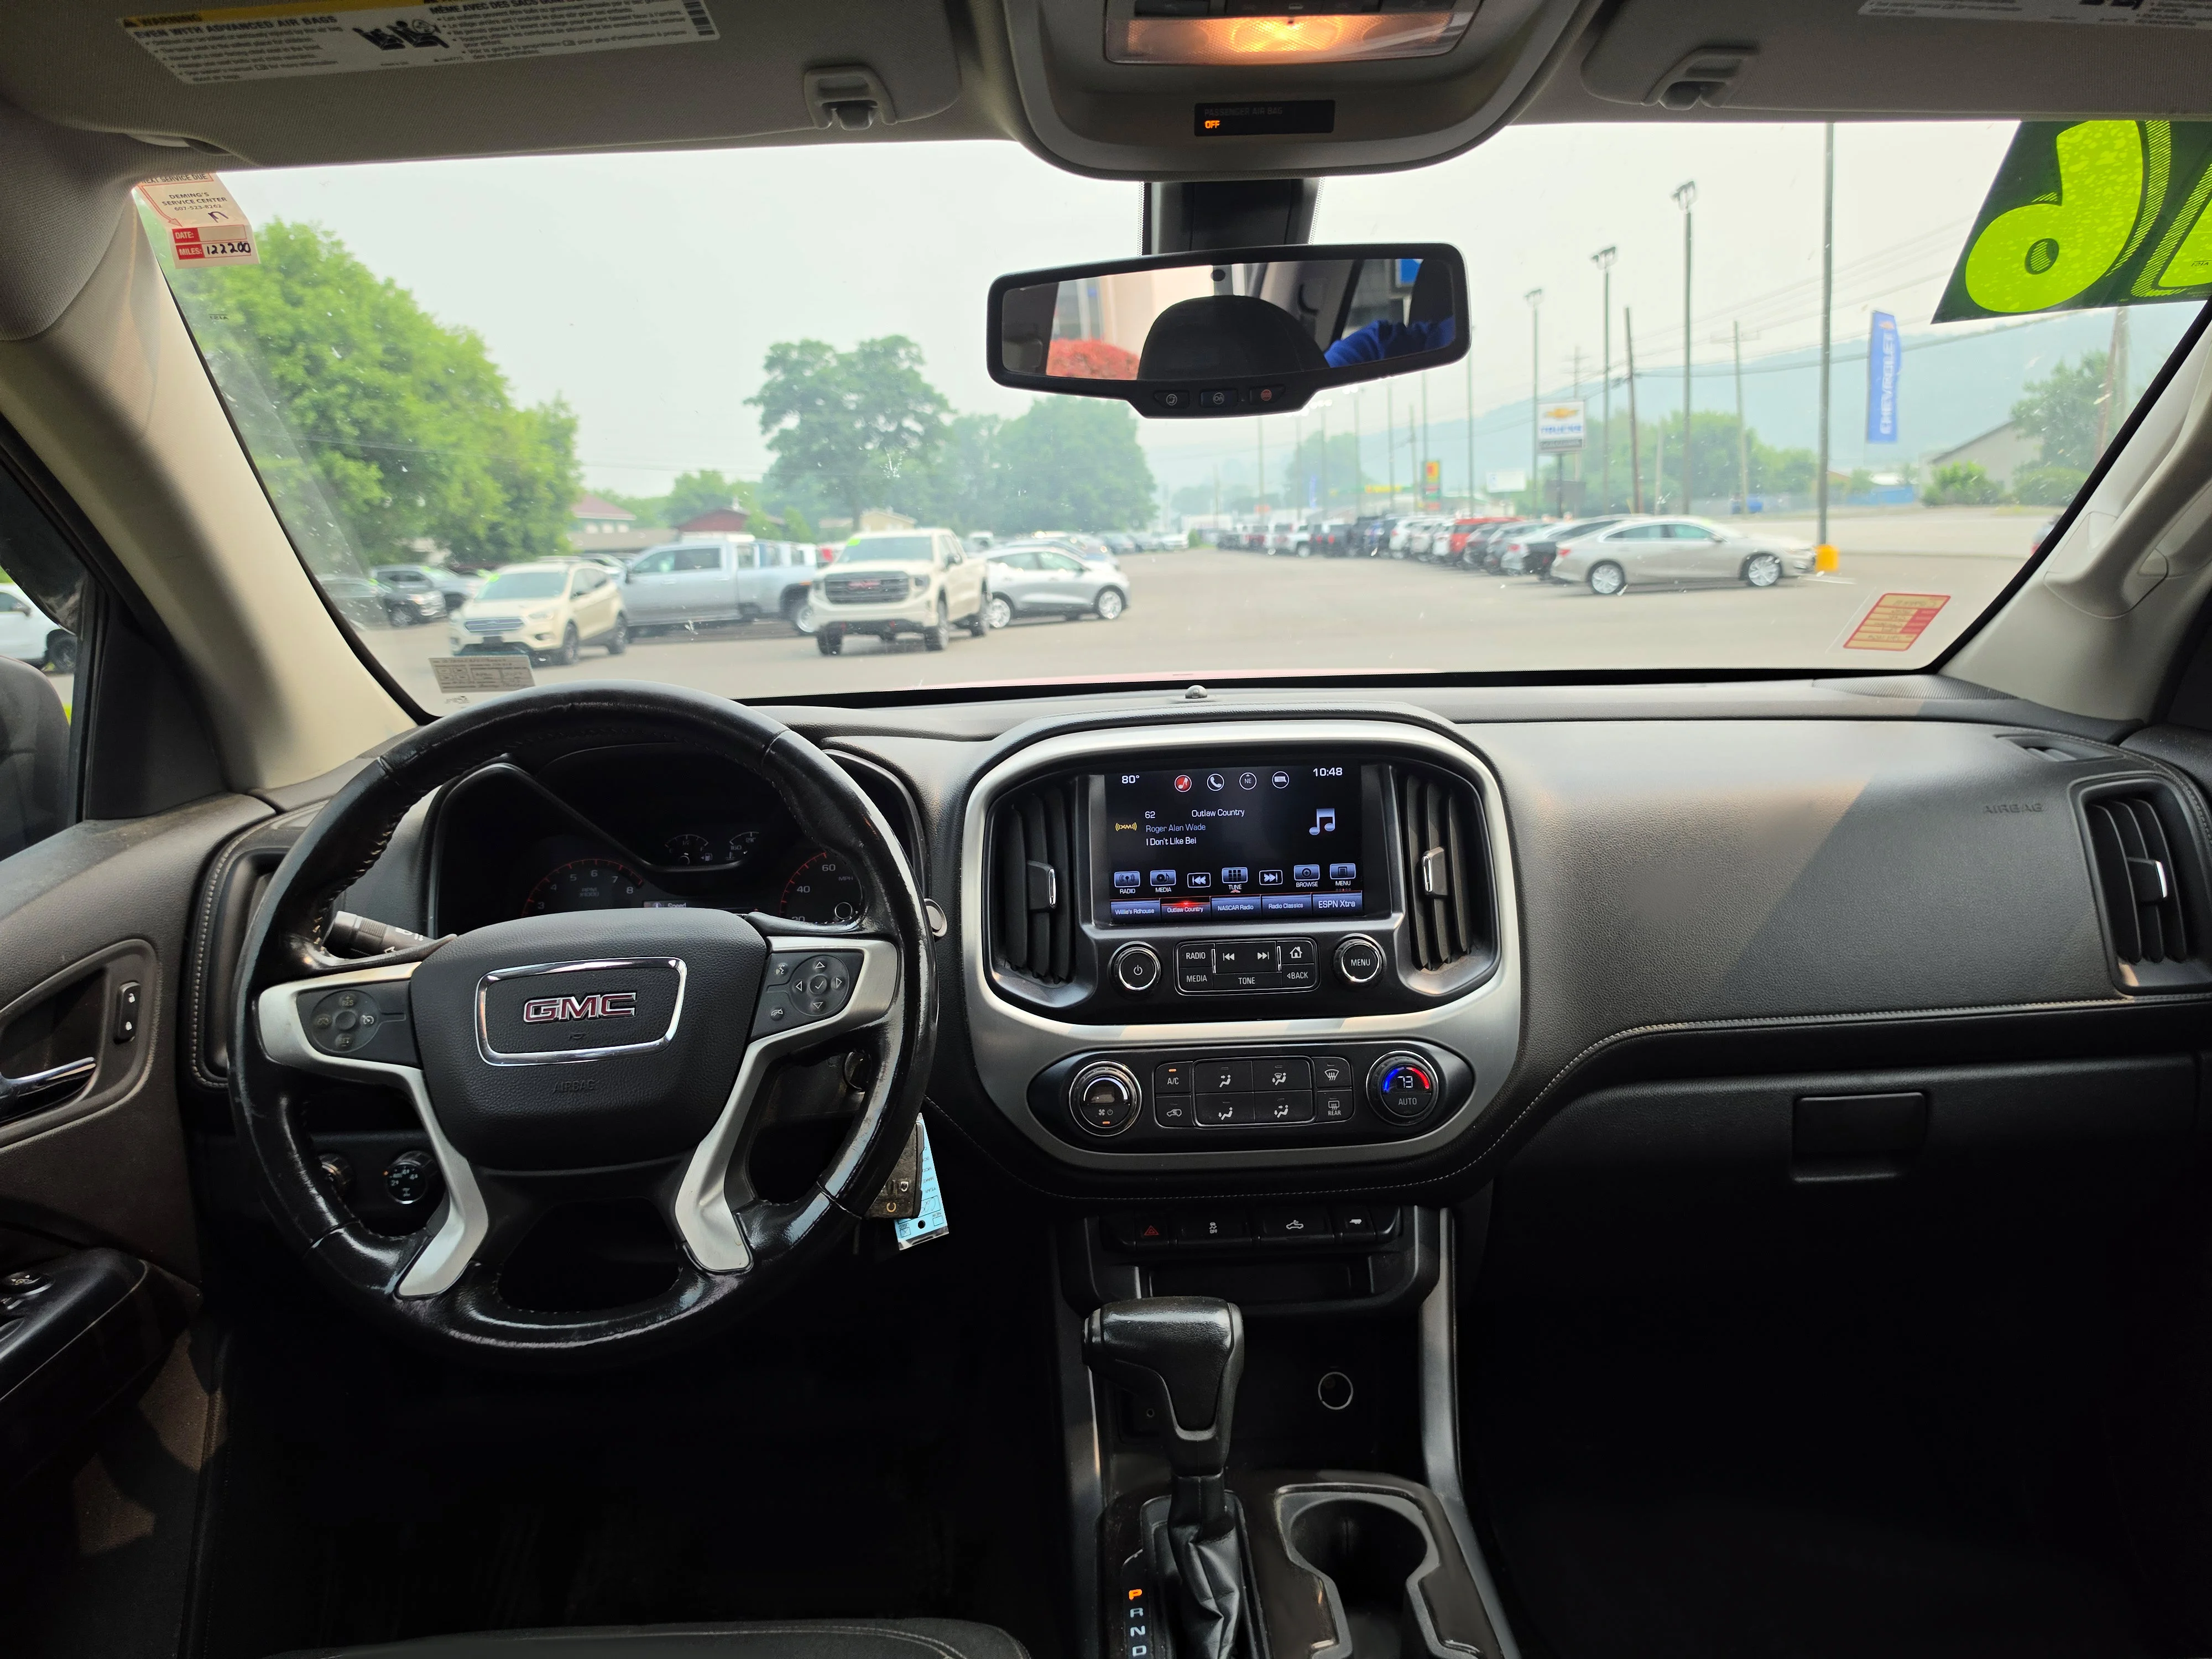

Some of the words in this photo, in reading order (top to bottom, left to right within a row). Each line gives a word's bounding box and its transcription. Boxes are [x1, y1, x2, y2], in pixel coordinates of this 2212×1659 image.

[463, 2, 489, 11] AVEC
[490, 0, 510, 9] DES
[206, 21, 274, 32] ADVANCED
[302, 15, 337, 25] BAGS
[1204, 120, 1220, 129] OFF
[160, 174, 191, 183] SERVICE
[175, 231, 194, 239] DATE:
[179, 247, 202, 256] MILES:
[206, 241, 252, 255] 122200
[1313, 767, 1343, 777] 10:48
[1145, 811, 1156, 819] 62
[1191, 809, 1216, 817] Outlaw
[1217, 808, 1245, 817] Country
[1146, 825, 1167, 834] Roger
[1168, 824, 1184, 832] Alan
[1185, 823, 1207, 831] Wade
[1146, 838, 1149, 846] I
[1150, 837, 1168, 846] Don't
[1170, 836, 1184, 845] Like
[570, 873, 577, 881] 5
[591, 869, 598, 878] 6
[612, 875, 619, 884] 7
[796, 885, 811, 894] 40
[538, 901, 545, 910] 3
[1318, 900, 1338, 909] ESPN
[1339, 900, 1356, 908] Xtra
[1350, 958, 1371, 967] MENU
[1186, 974, 1208, 983] MEDIA
[1238, 976, 1255, 984] TONE
[1290, 971, 1308, 980] BACK
[523, 992, 637, 1023] GMC
[1397, 1075, 1413, 1088] 73
[1398, 1097, 1418, 1106] AUTO
[1129, 1589, 1142, 1601] P
[1130, 1608, 1144, 1618] R
[1130, 1625, 1146, 1637] N
[1132, 1645, 1147, 1657] D
